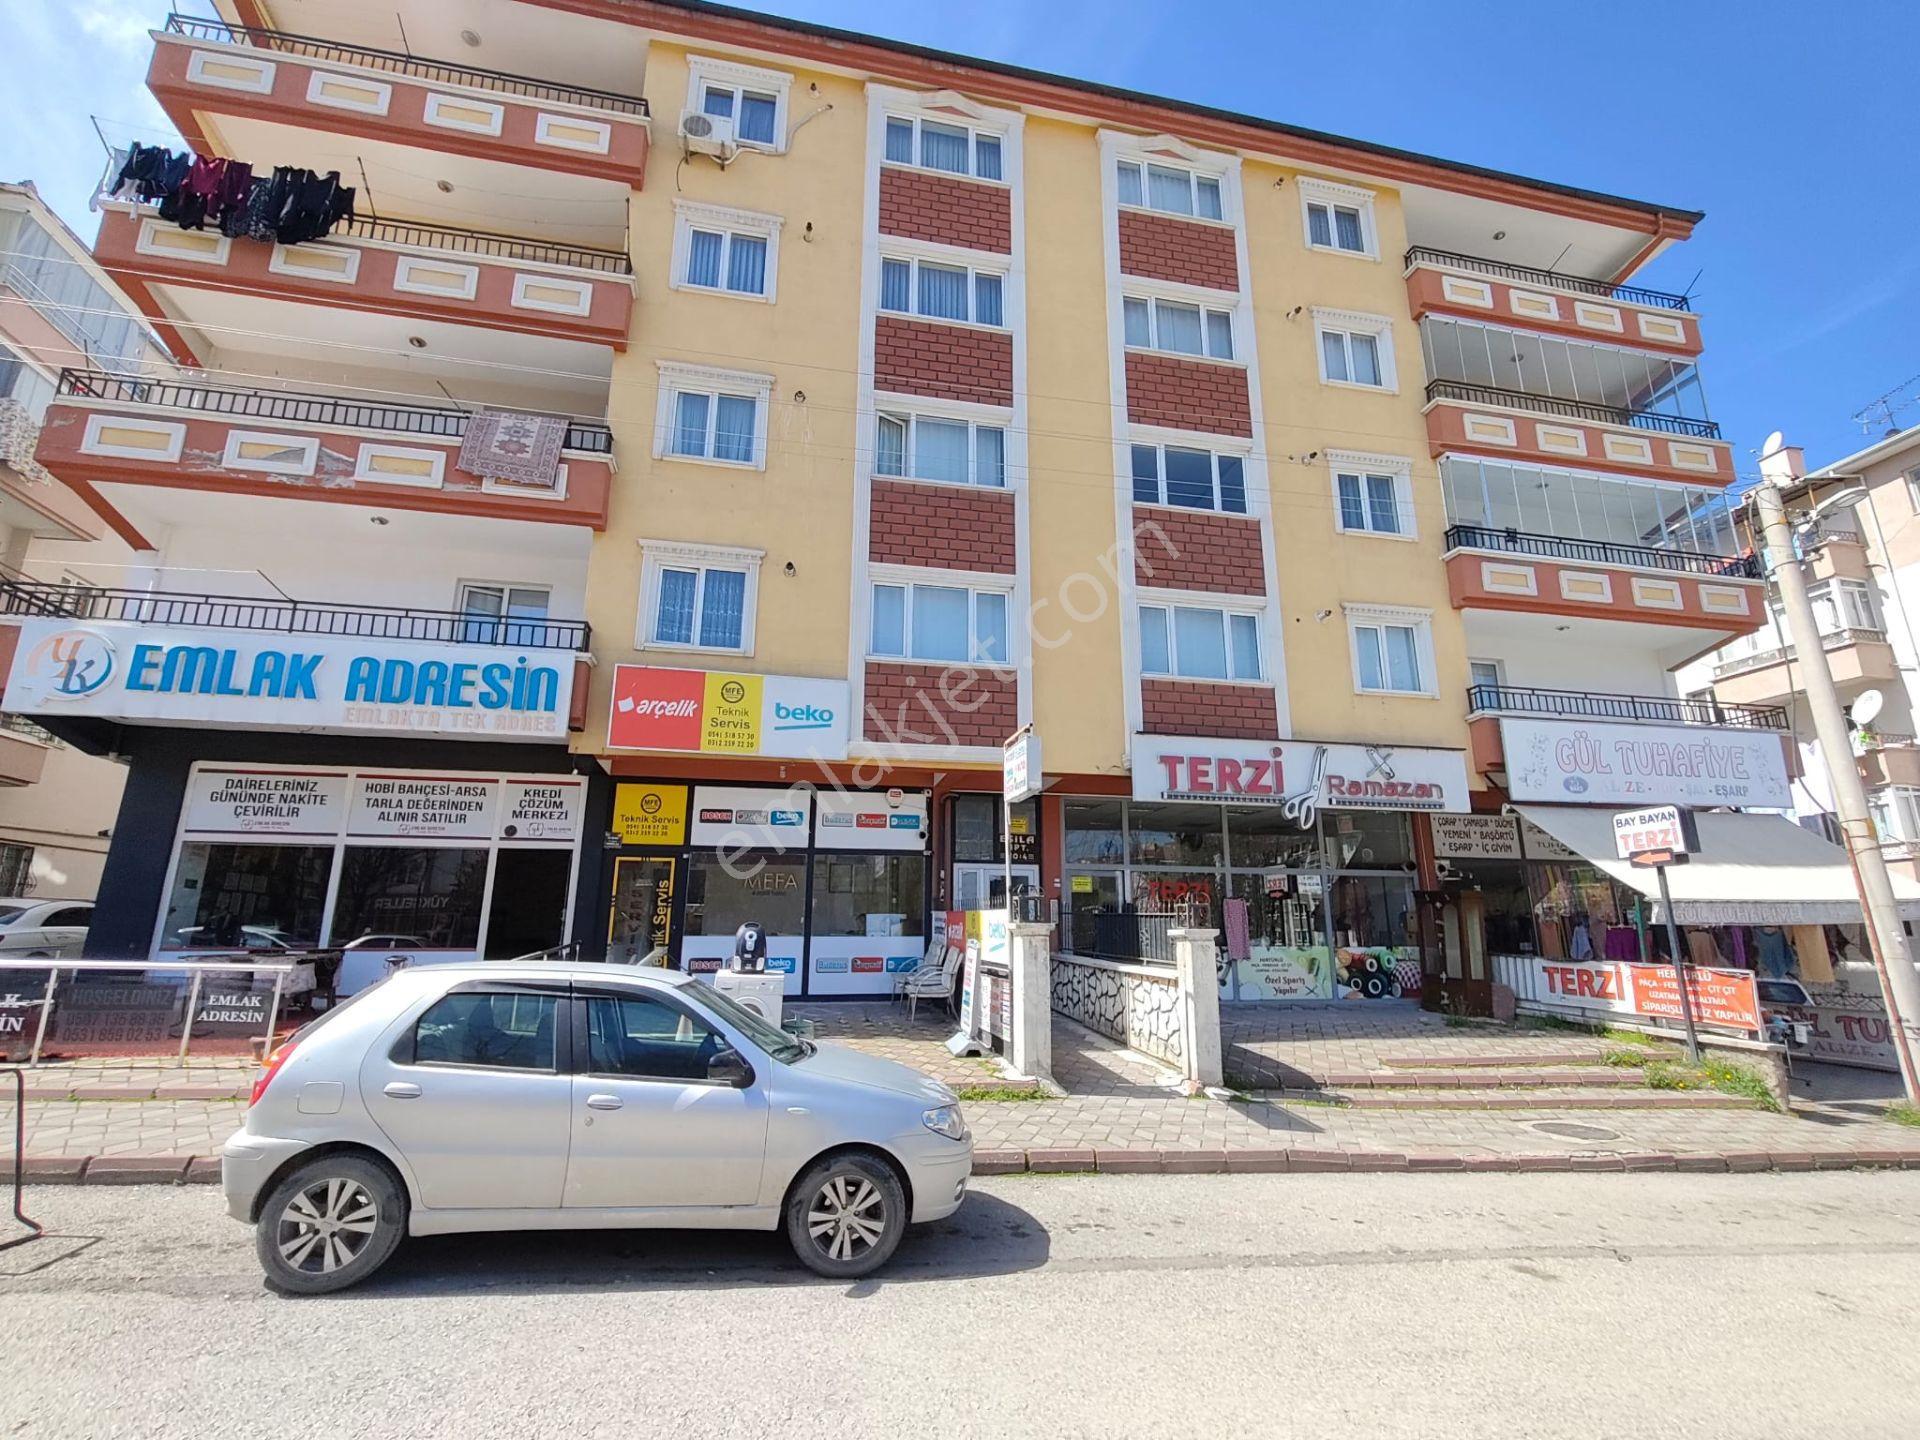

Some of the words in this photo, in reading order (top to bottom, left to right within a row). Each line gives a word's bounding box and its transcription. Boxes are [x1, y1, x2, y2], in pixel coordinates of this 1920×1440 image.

[125, 644, 325, 699] EMLAK
[724, 687, 742, 696] MFE
[636, 698, 699, 719] arçelik
[716, 706, 750, 718] Teknik
[774, 703, 834, 723] beko
[343, 706, 441, 729] EMLAKTA
[449, 712, 487, 730] TEK
[494, 713, 557, 733] ADRES
[710, 717, 751, 730] Servis
[1555, 730, 1613, 775] GÜL
[1614, 736, 1751, 779] TUHAFİYE
[1157, 746, 1286, 795] TERZİ
[1325, 774, 1444, 799] Ramazan
[225, 778, 318, 793] DAİRELERİNİZ
[365, 782, 395, 794] HOBİ
[398, 784, 487, 798] BAHÇESİ-ARSA
[1713, 783, 1750, 799] EŞARP
[210, 790, 275, 804] GÜNÜNDE
[278, 792, 328, 806] NAKİTE
[523, 788, 562, 799] KREDİ
[233, 803, 300, 818] ÇEVİRİLİR
[365, 798, 403, 810] TARLA
[407, 798, 483, 812] DEĞERİNDEN
[518, 798, 563, 811] ÇÖZÜM
[377, 811, 418, 824] ALINIR
[421, 812, 467, 825] SATILIR
[511, 809, 569, 821] MERKEZİ
[620, 814, 648, 823] Teknik
[651, 815, 680, 825] Servis
[1615, 816, 1636, 828] BAY
[1639, 810, 1676, 825] BAYAN
[1437, 817, 1457, 828] ÇORAP
[1462, 818, 1490, 829] ÇAMAŞIR
[1442, 828, 1472, 840] YEMENİ
[1479, 829, 1515, 841] BAŞÖRTÜ
[1619, 821, 1680, 851] TERZİ
[1448, 842, 1474, 852] EŞARP
[1481, 841, 1491, 854] İÇ
[1491, 843, 1513, 853] GİYİM
[744, 873, 799, 890] MEFA
[653, 880, 670, 925] Servis
[768, 959, 792, 969] beko
[1542, 961, 1626, 1001] TERZİ
[1656, 969, 1678, 979] HER
[207, 994, 262, 1008] EMLAK
[197, 1009, 264, 1024] ADRESİN
[1714, 1009, 1753, 1023] YAPILIR
